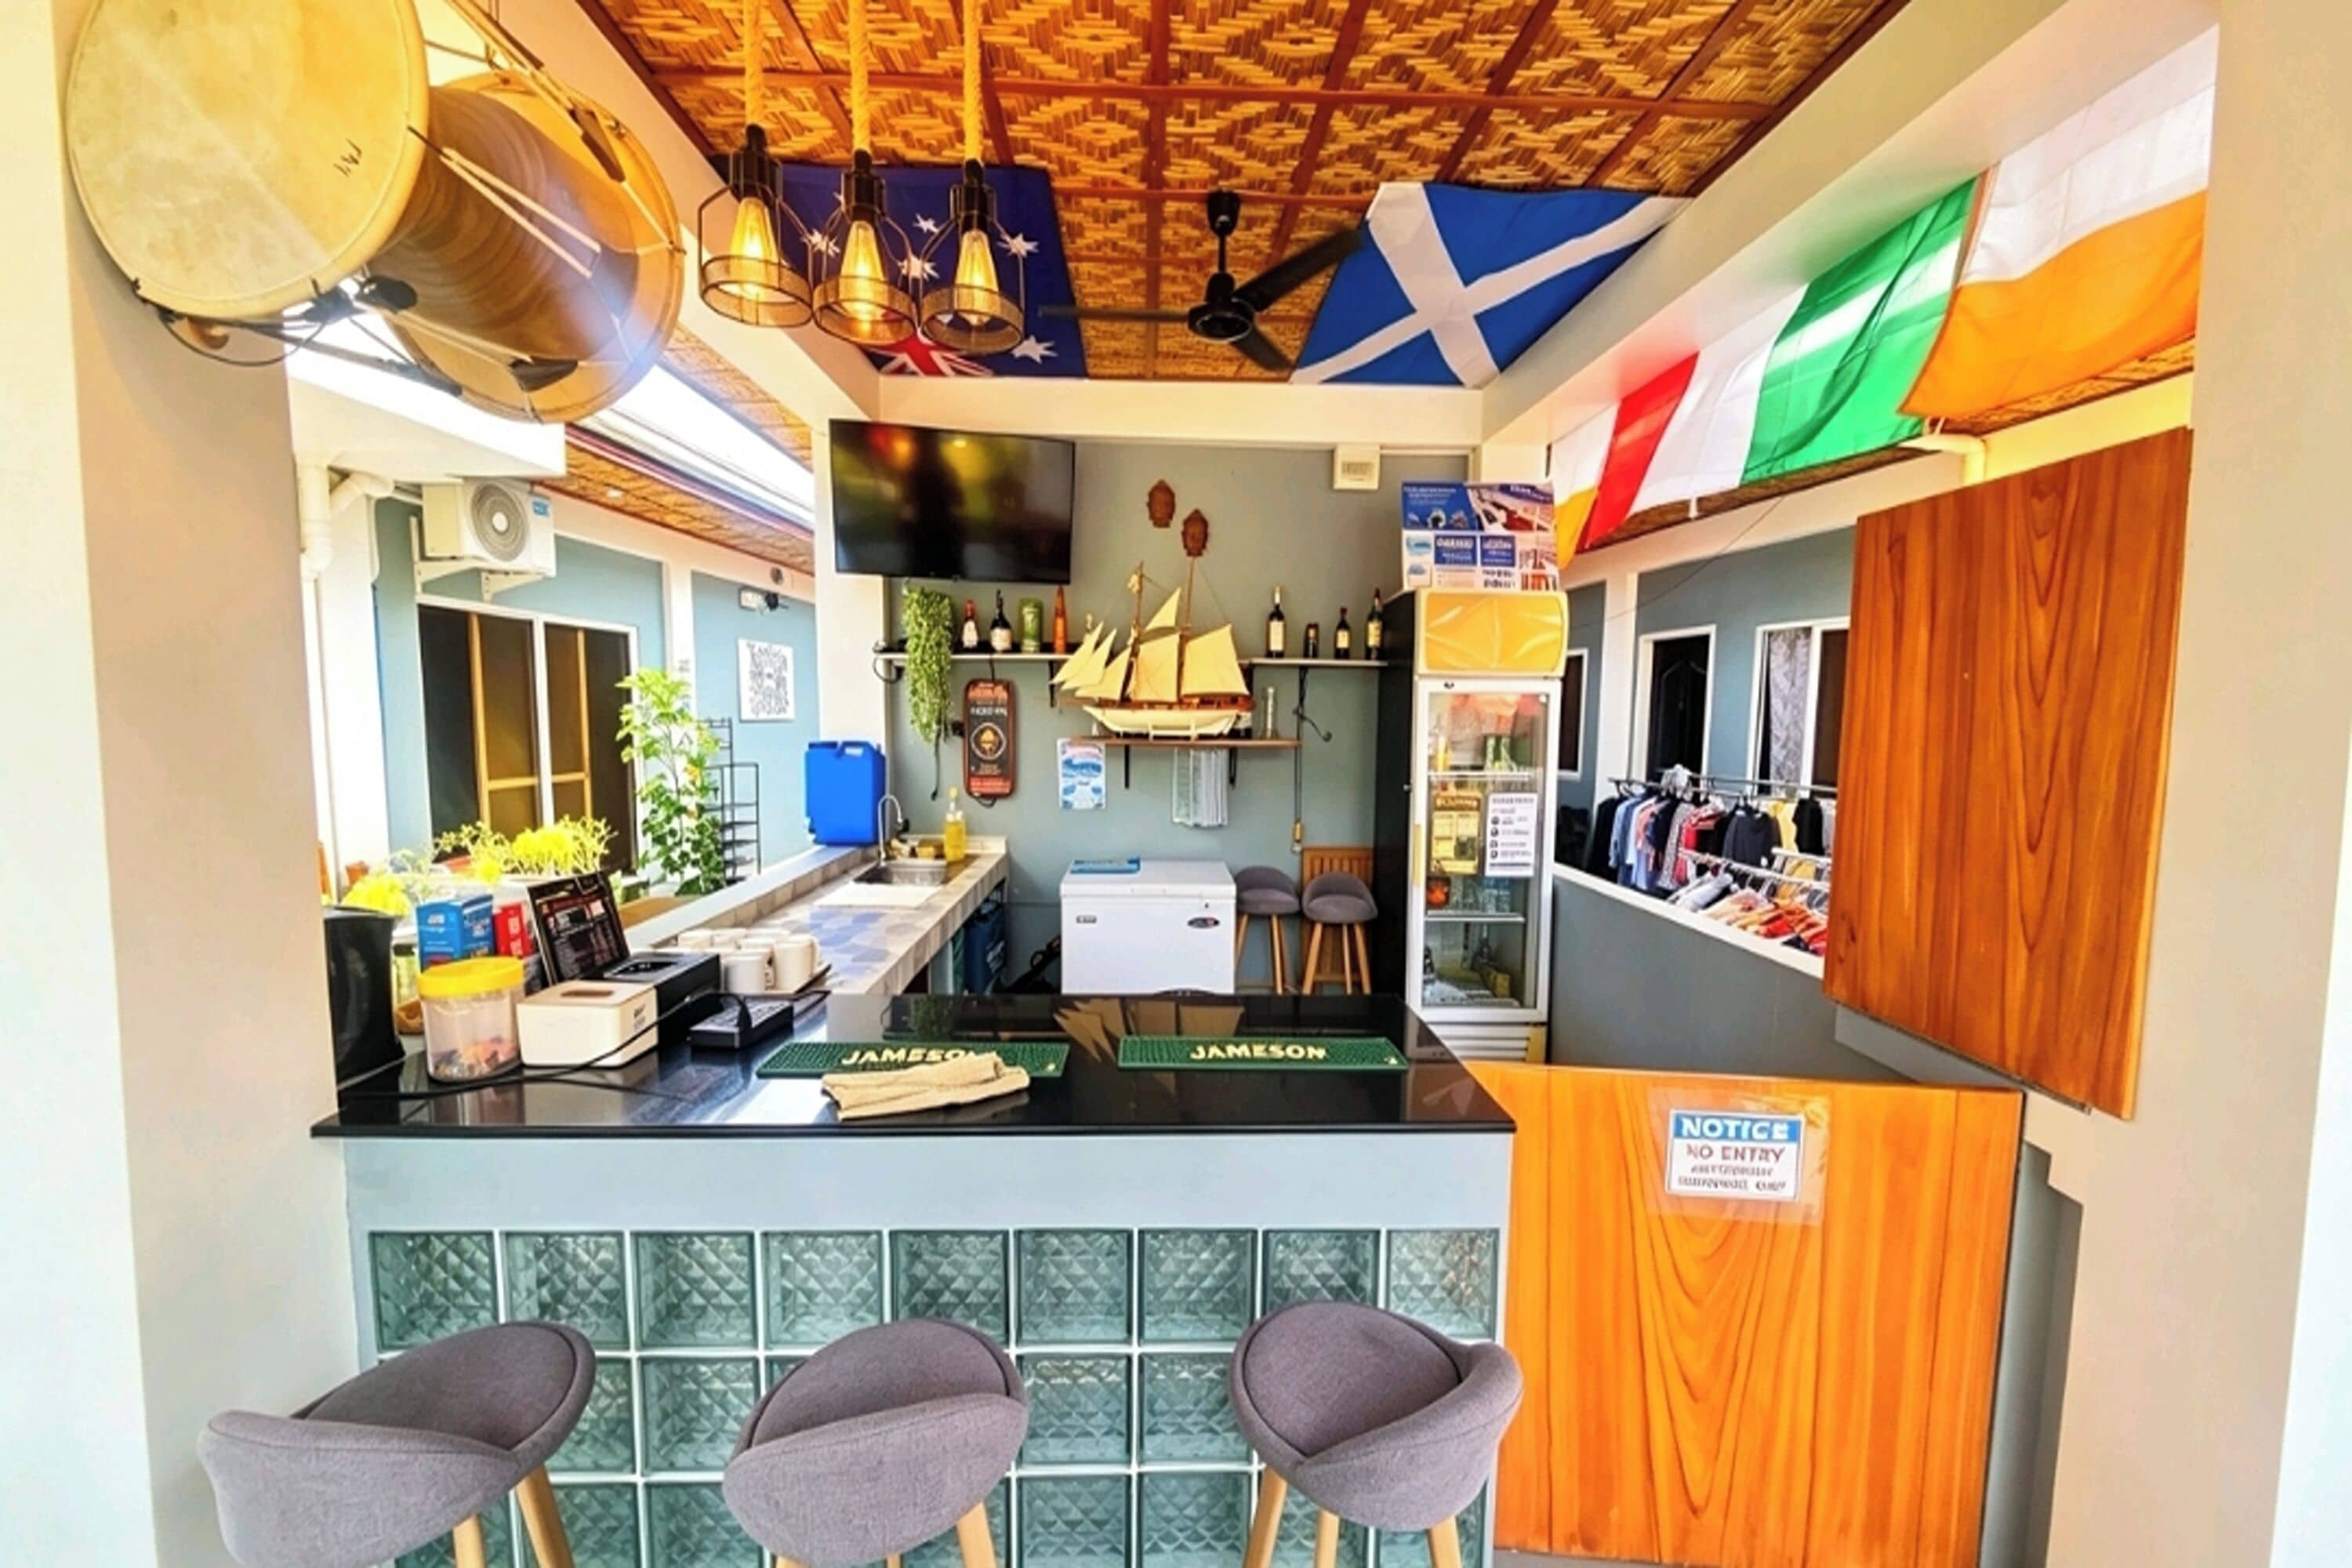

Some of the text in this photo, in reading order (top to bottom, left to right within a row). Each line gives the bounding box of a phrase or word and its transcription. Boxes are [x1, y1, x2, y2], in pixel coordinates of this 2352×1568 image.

[841, 1047, 977, 1065] JAMESO
[1189, 1044, 1327, 1060] JAMESON
[1681, 1116, 1790, 1140] NOTICE
[1686, 1143, 1784, 1163] NO ENTRY
